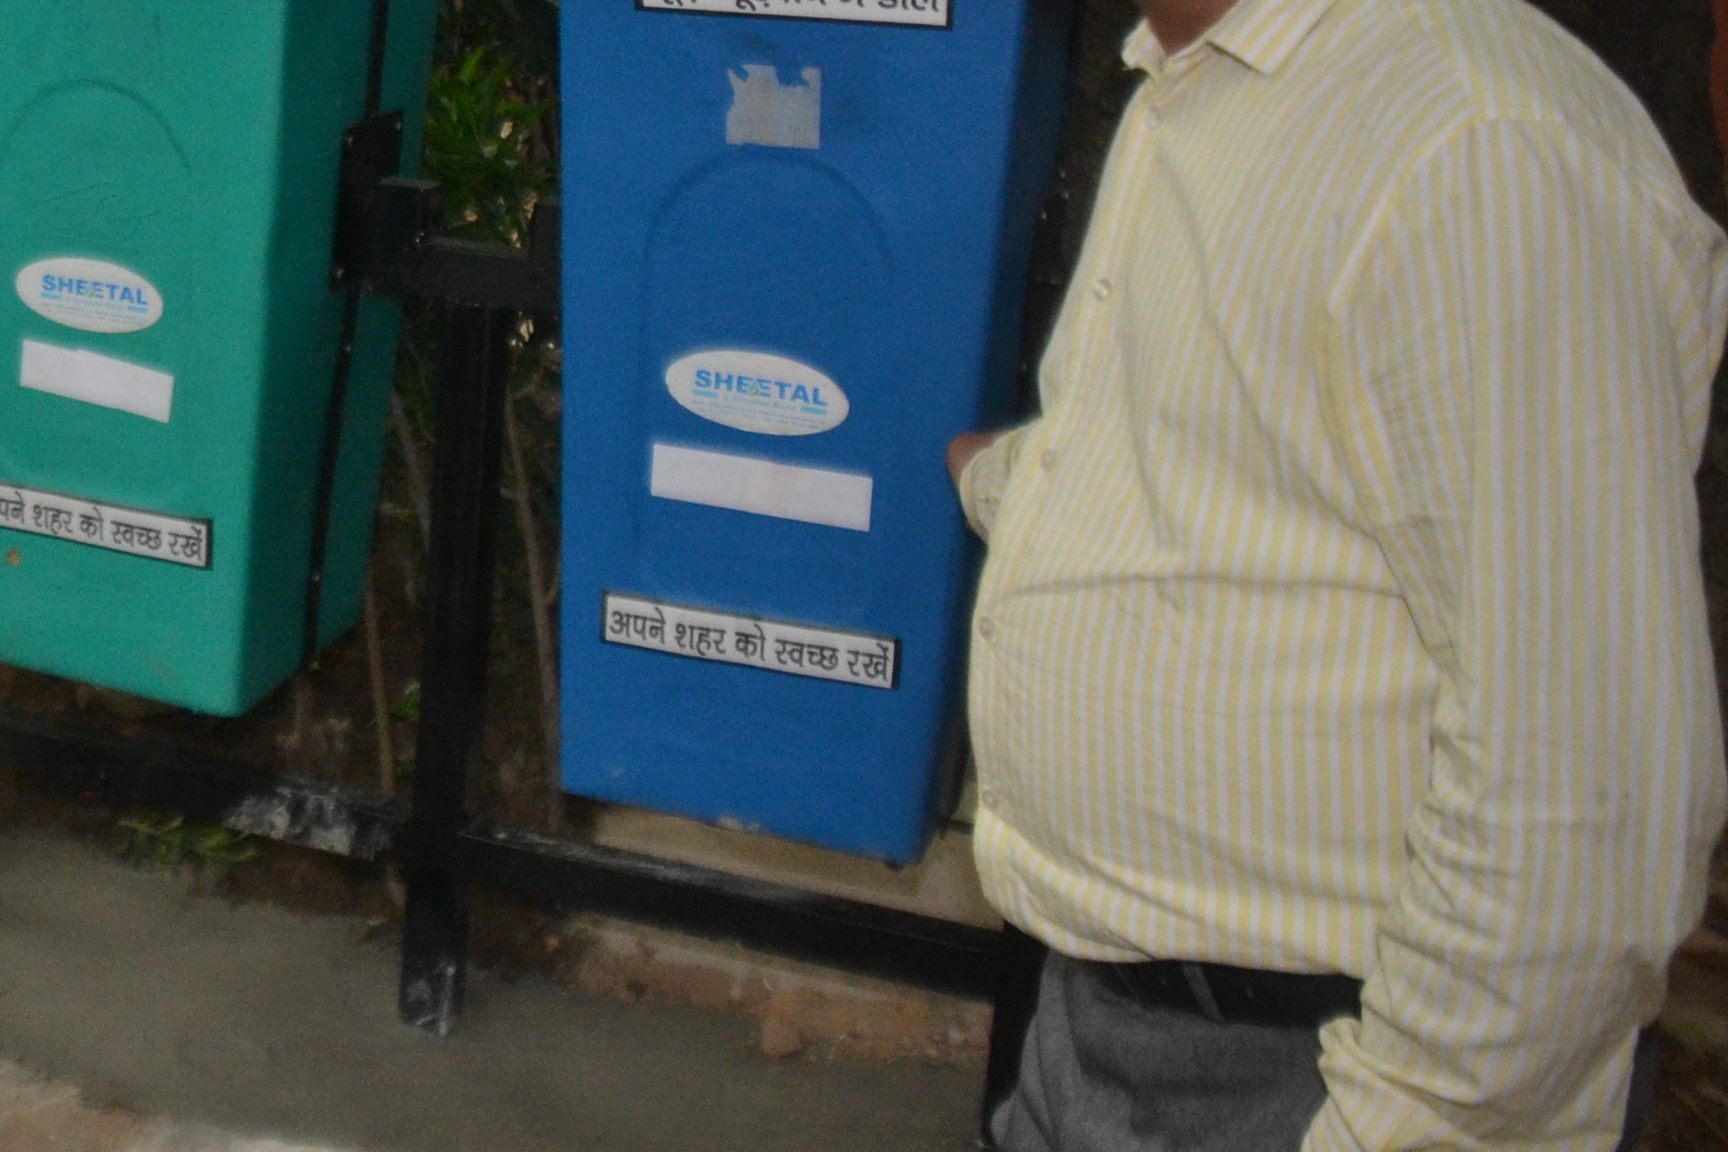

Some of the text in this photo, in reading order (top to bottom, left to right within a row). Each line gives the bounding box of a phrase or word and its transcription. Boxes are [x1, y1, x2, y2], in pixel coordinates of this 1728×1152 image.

[41, 274, 149, 306] SHEETAL
[694, 368, 829, 407] SHEETAL
[32, 504, 74, 535] शहर
[79, 506, 104, 540] को
[110, 520, 163, 550] स्वच्छ
[609, 606, 666, 645] अपने
[675, 621, 727, 656] शहर
[734, 623, 766, 661] को
[775, 637, 840, 672] स्वच्छ
